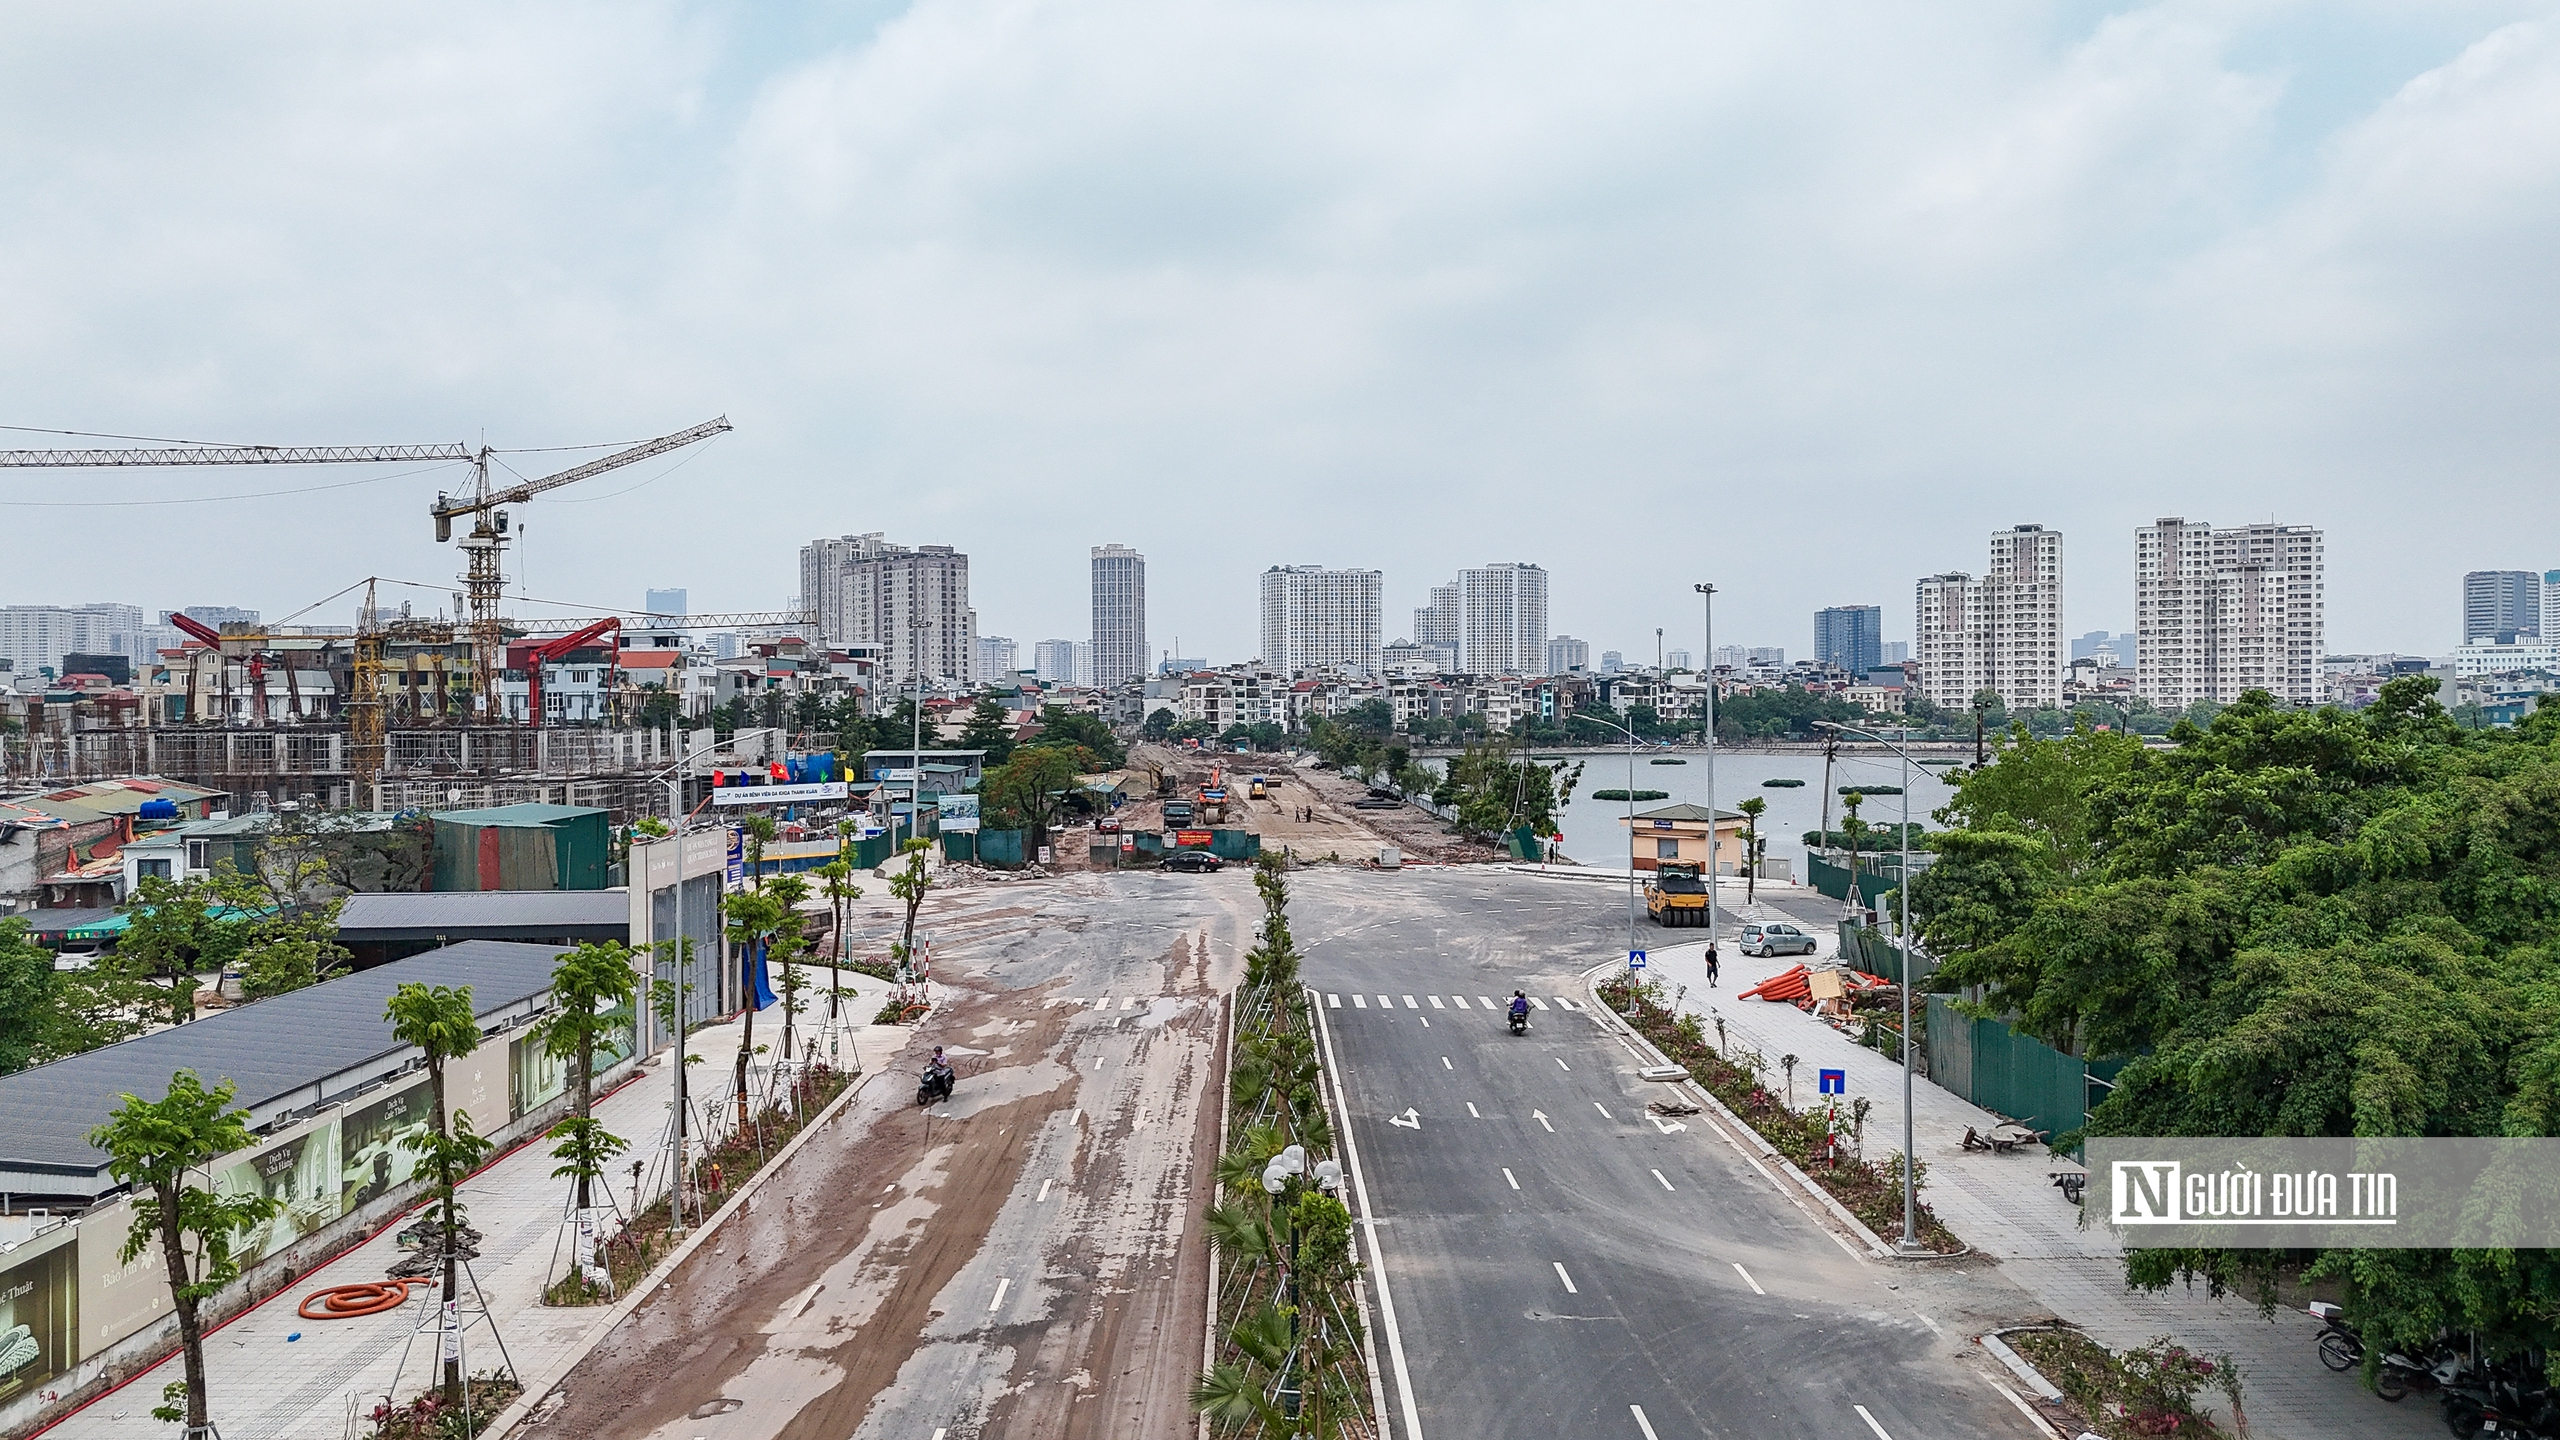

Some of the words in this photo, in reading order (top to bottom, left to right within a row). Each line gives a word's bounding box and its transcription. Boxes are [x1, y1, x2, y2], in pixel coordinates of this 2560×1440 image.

[269, 1152, 282, 1165] Dịch
[282, 1149, 291, 1159] Vụ
[266, 1162, 279, 1177] Nhà
[278, 1158, 294, 1171] Hàng
[102, 1269, 121, 1288] Bảo
[8, 1280, 34, 1300] Thuật
